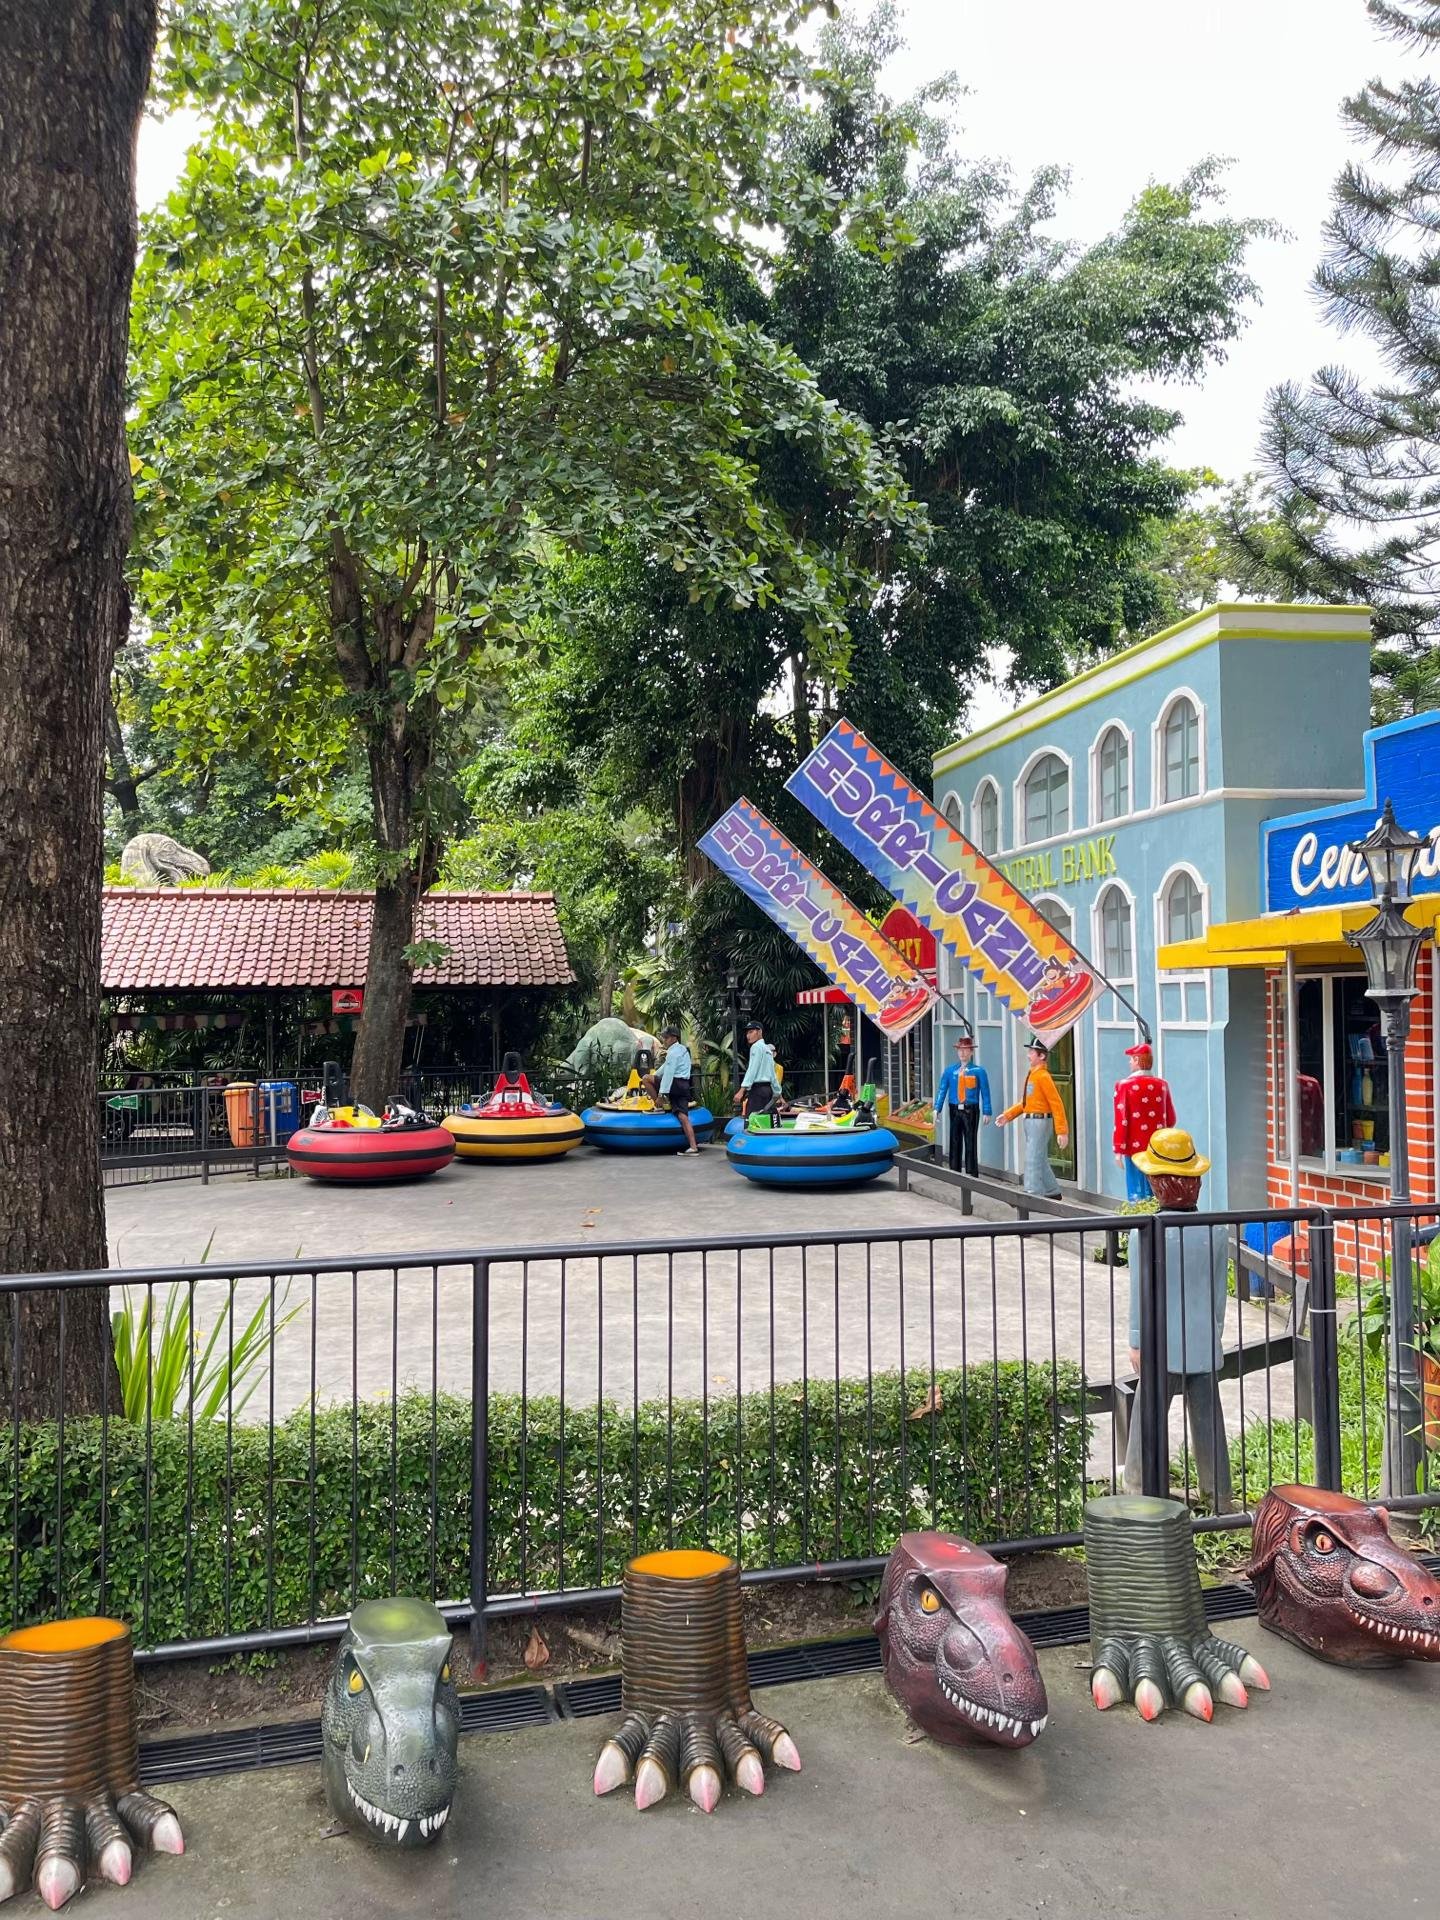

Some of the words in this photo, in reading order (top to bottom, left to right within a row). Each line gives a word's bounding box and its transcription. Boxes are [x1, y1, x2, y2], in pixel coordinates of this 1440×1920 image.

[710, 810, 896, 1004] HURRICANE
[803, 738, 1046, 993] HURRICANE
[997, 850, 1059, 892] NTRAL
[1062, 833, 1118, 884] BANK
